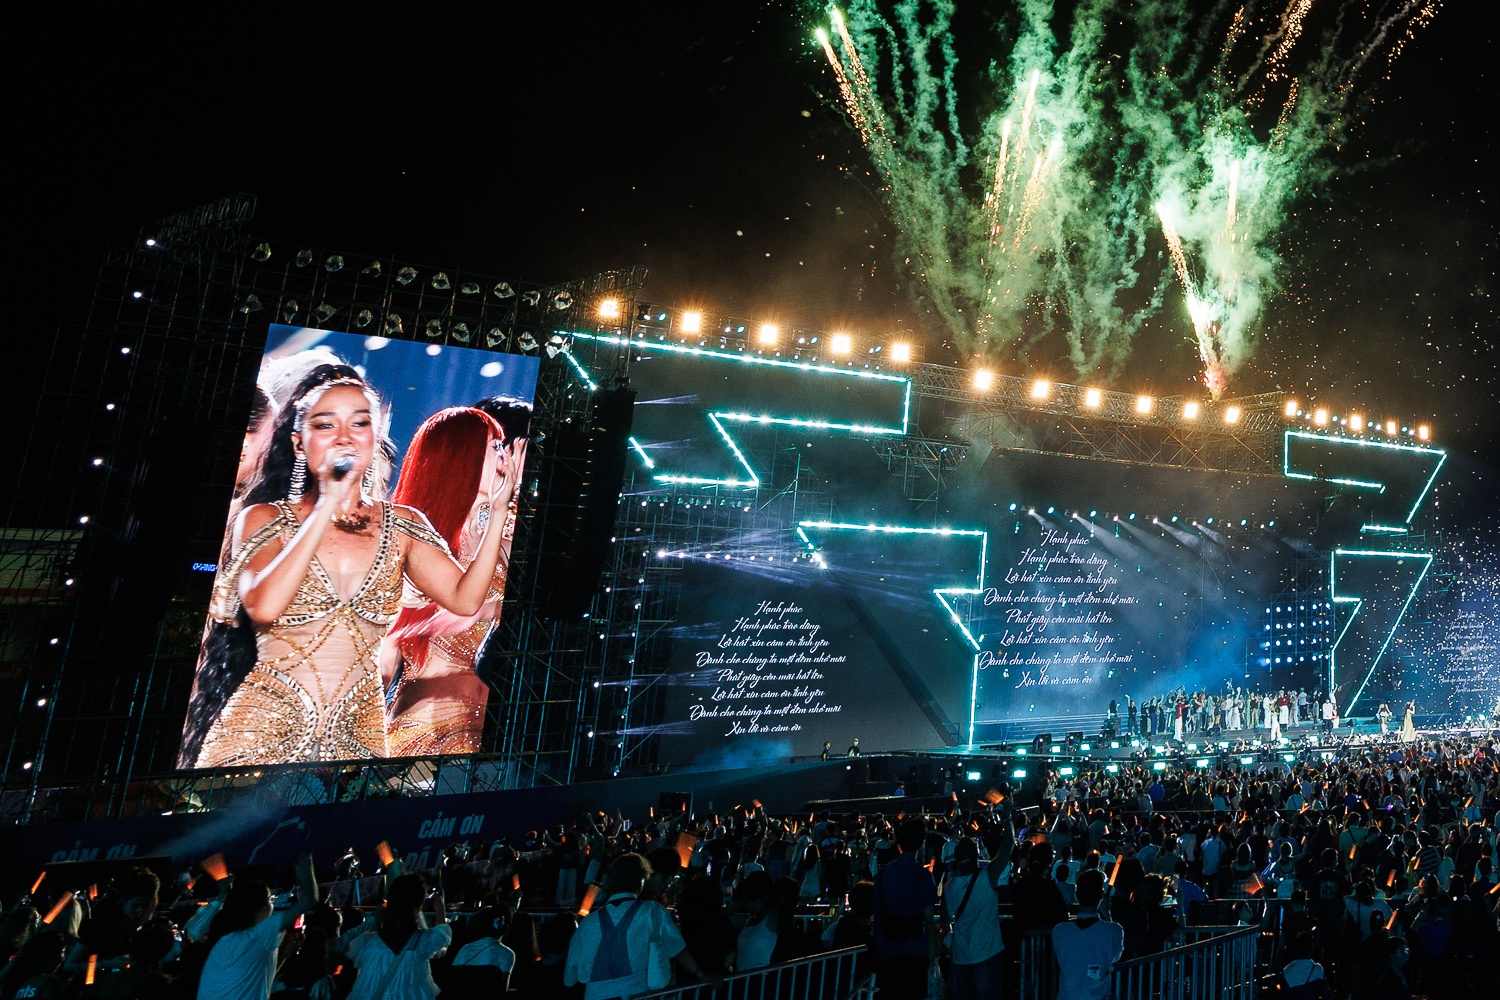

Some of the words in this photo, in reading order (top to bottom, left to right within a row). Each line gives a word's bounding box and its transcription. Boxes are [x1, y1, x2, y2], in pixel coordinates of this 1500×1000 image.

[1037, 574, 1053, 583] xin
[750, 639, 765, 647] xin
[1032, 636, 1048, 644] xin
[1015, 671, 1038, 689] Xin
[744, 691, 759, 699] xin
[725, 721, 748, 737] Xin
[418, 811, 456, 839] CẢM
[459, 813, 485, 835] ƠN
